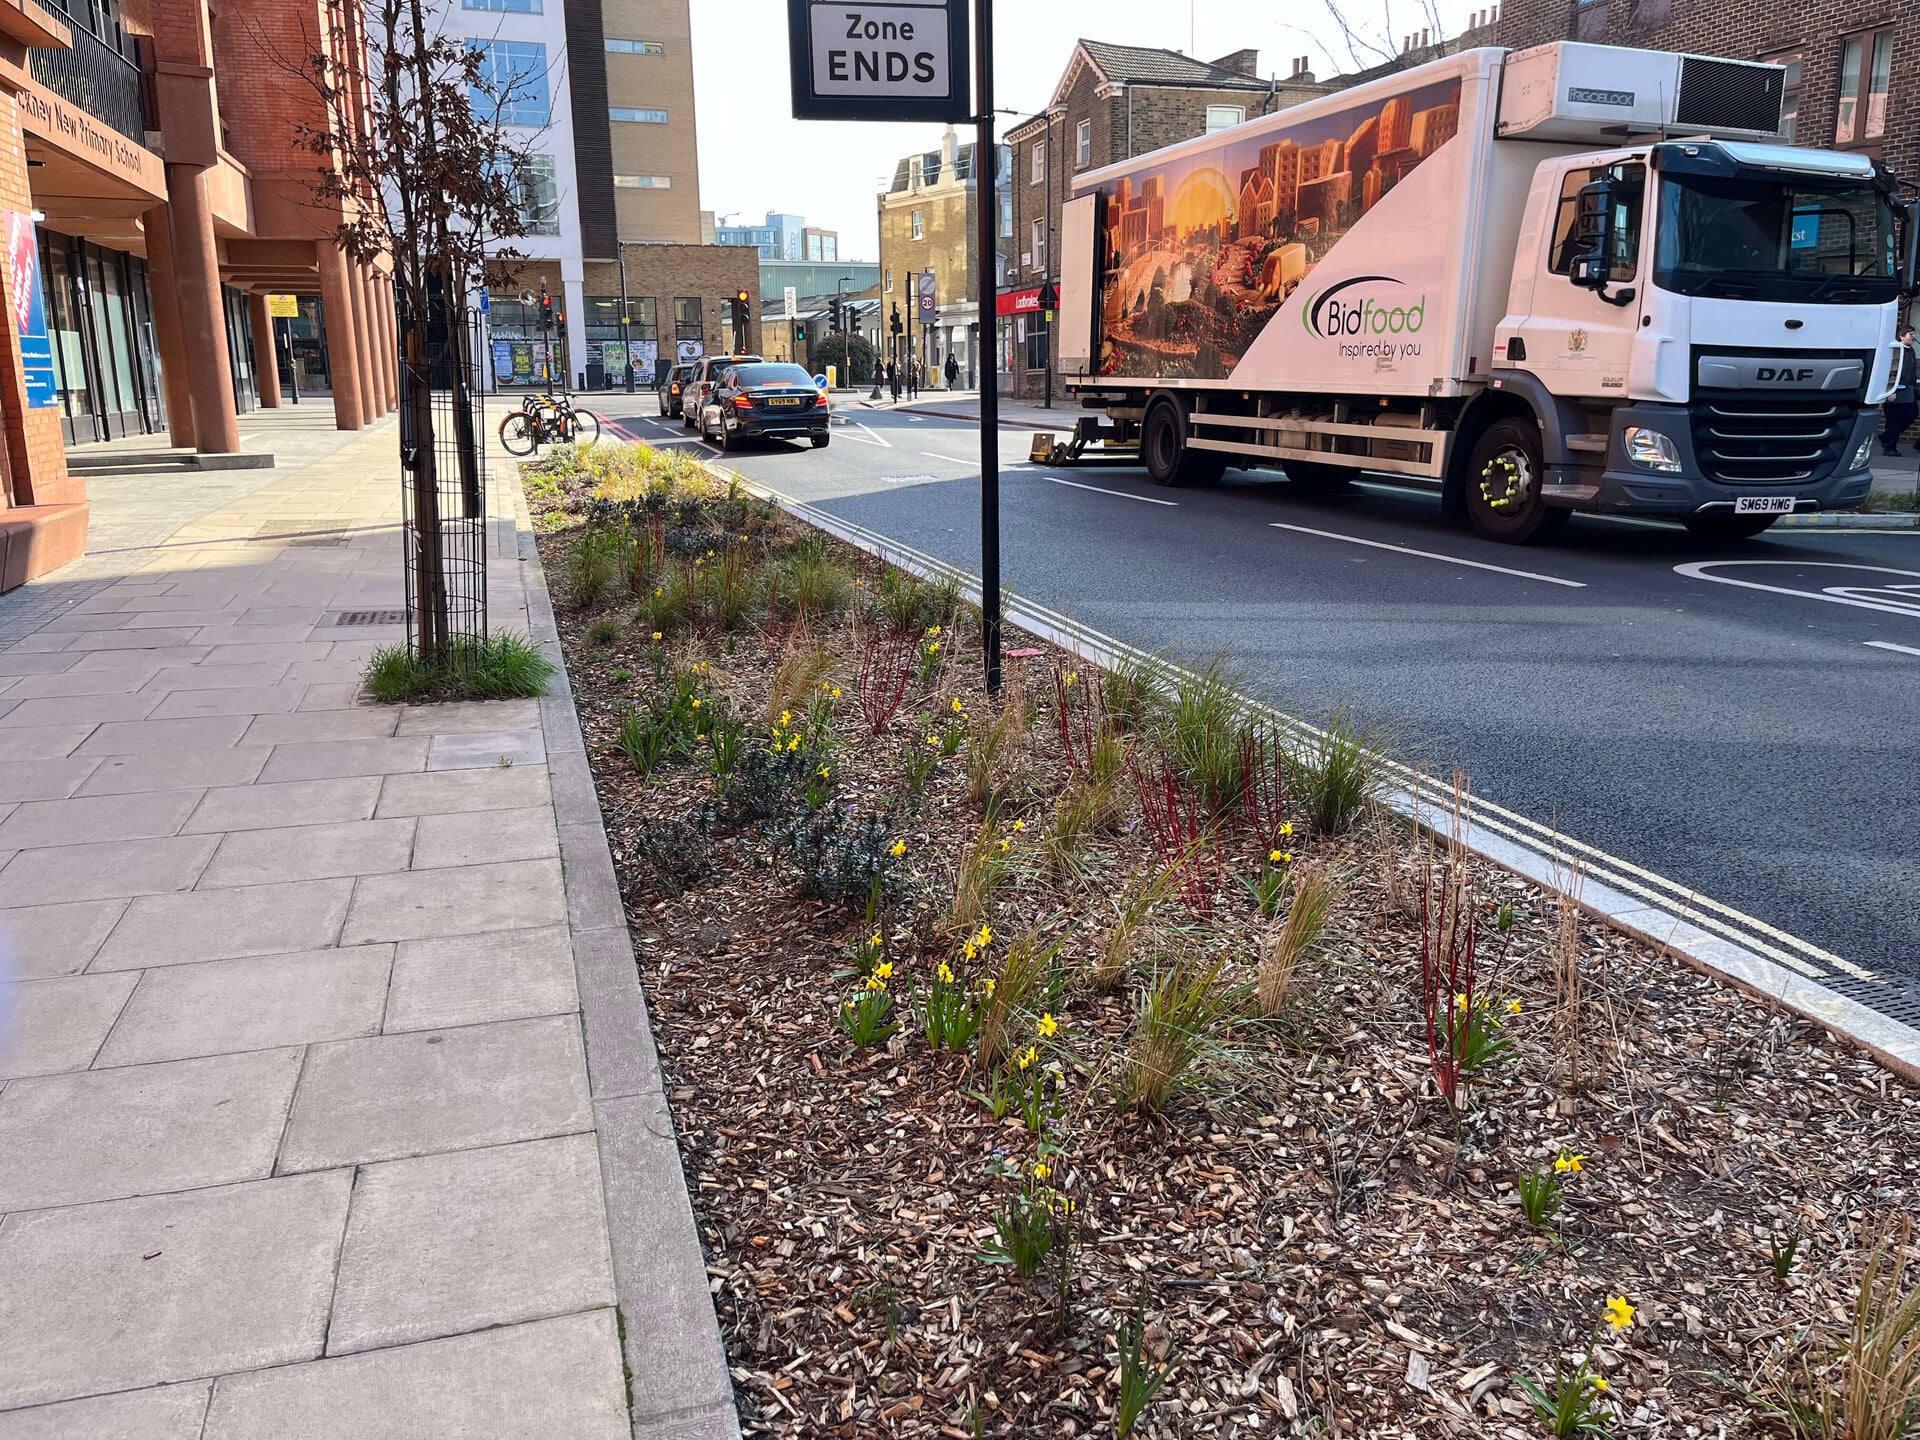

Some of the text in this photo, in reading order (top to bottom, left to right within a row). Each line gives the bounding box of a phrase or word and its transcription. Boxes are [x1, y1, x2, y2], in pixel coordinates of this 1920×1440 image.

[845, 13, 915, 41] Zone
[828, 50, 935, 83] ENDS
[17, 90, 142, 176] ckney New Primary School
[922, 299, 933, 307] 20
[1327, 294, 1426, 337] Bidfood
[1339, 340, 1421, 361] Inspired by you
[1756, 367, 1814, 382] DAF
